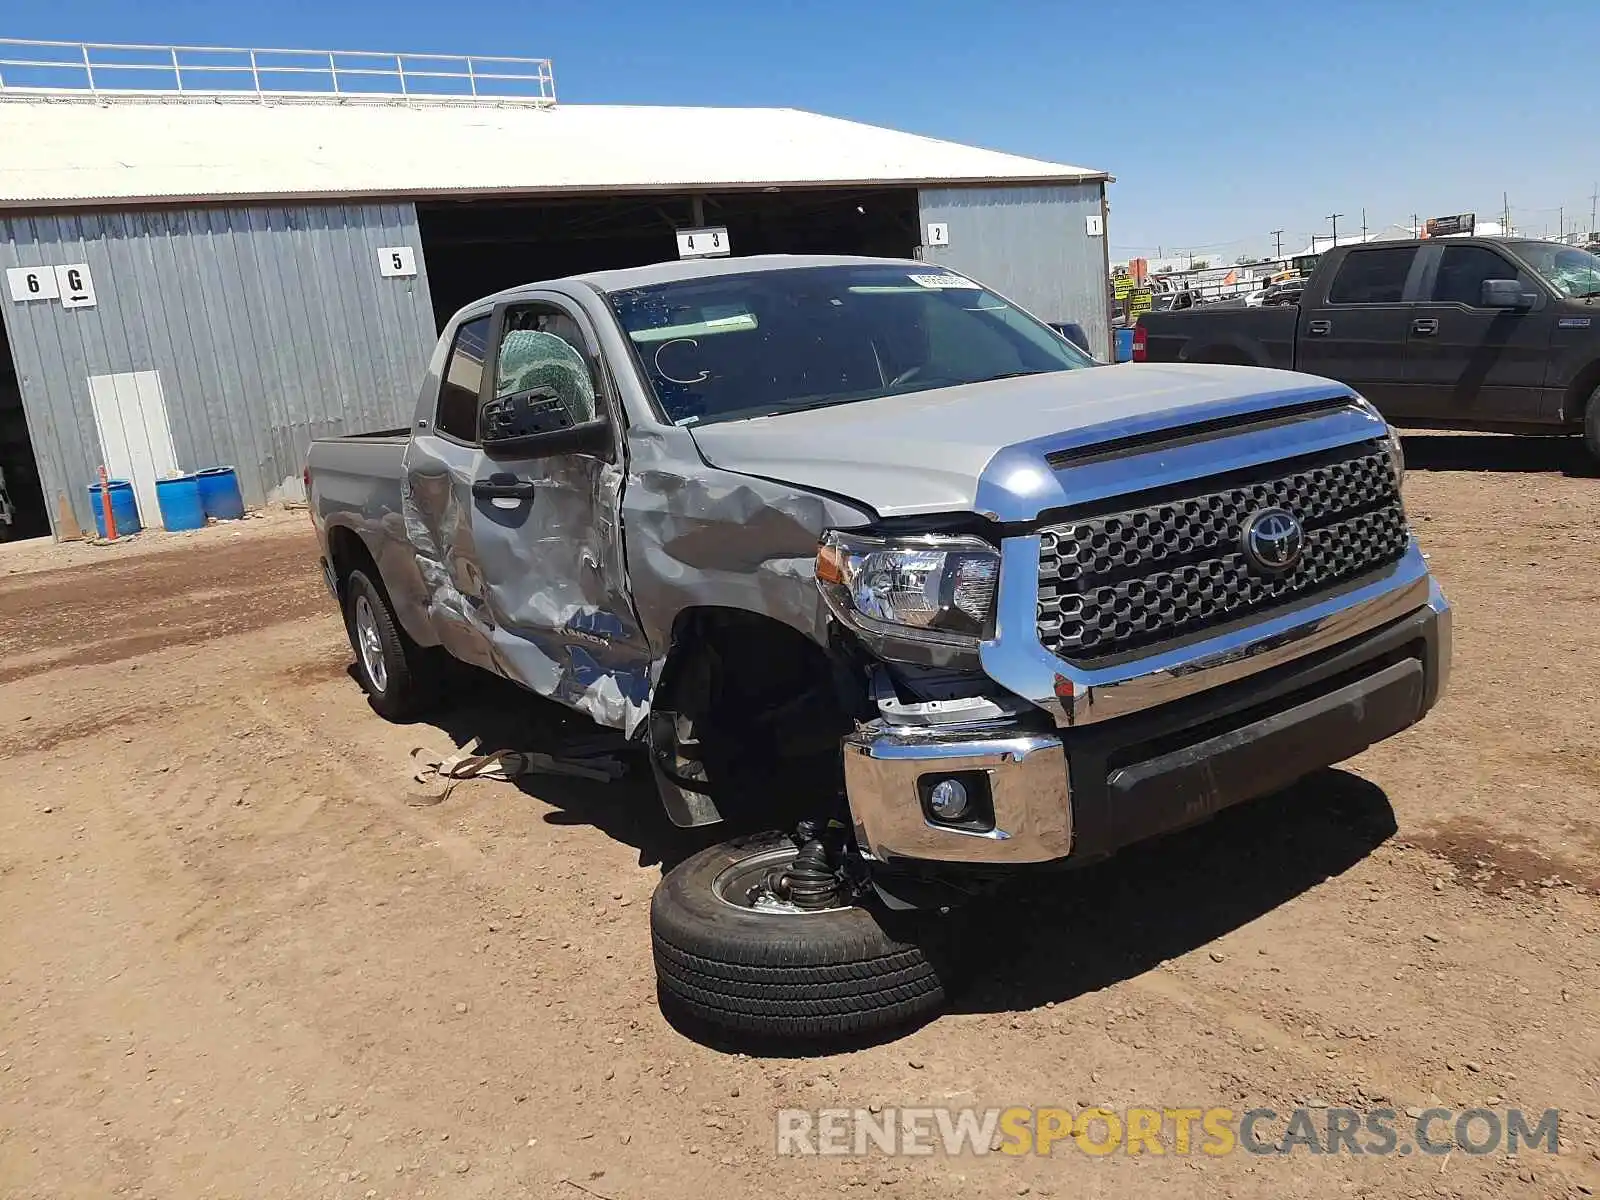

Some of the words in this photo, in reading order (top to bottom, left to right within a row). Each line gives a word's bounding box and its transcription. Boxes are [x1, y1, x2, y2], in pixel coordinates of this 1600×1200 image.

[687, 236, 696, 251] 4
[711, 233, 720, 248] 3
[935, 227, 942, 242] 2
[391, 253, 403, 270] 5
[26, 273, 40, 293] 6
[68, 269, 83, 291] G
